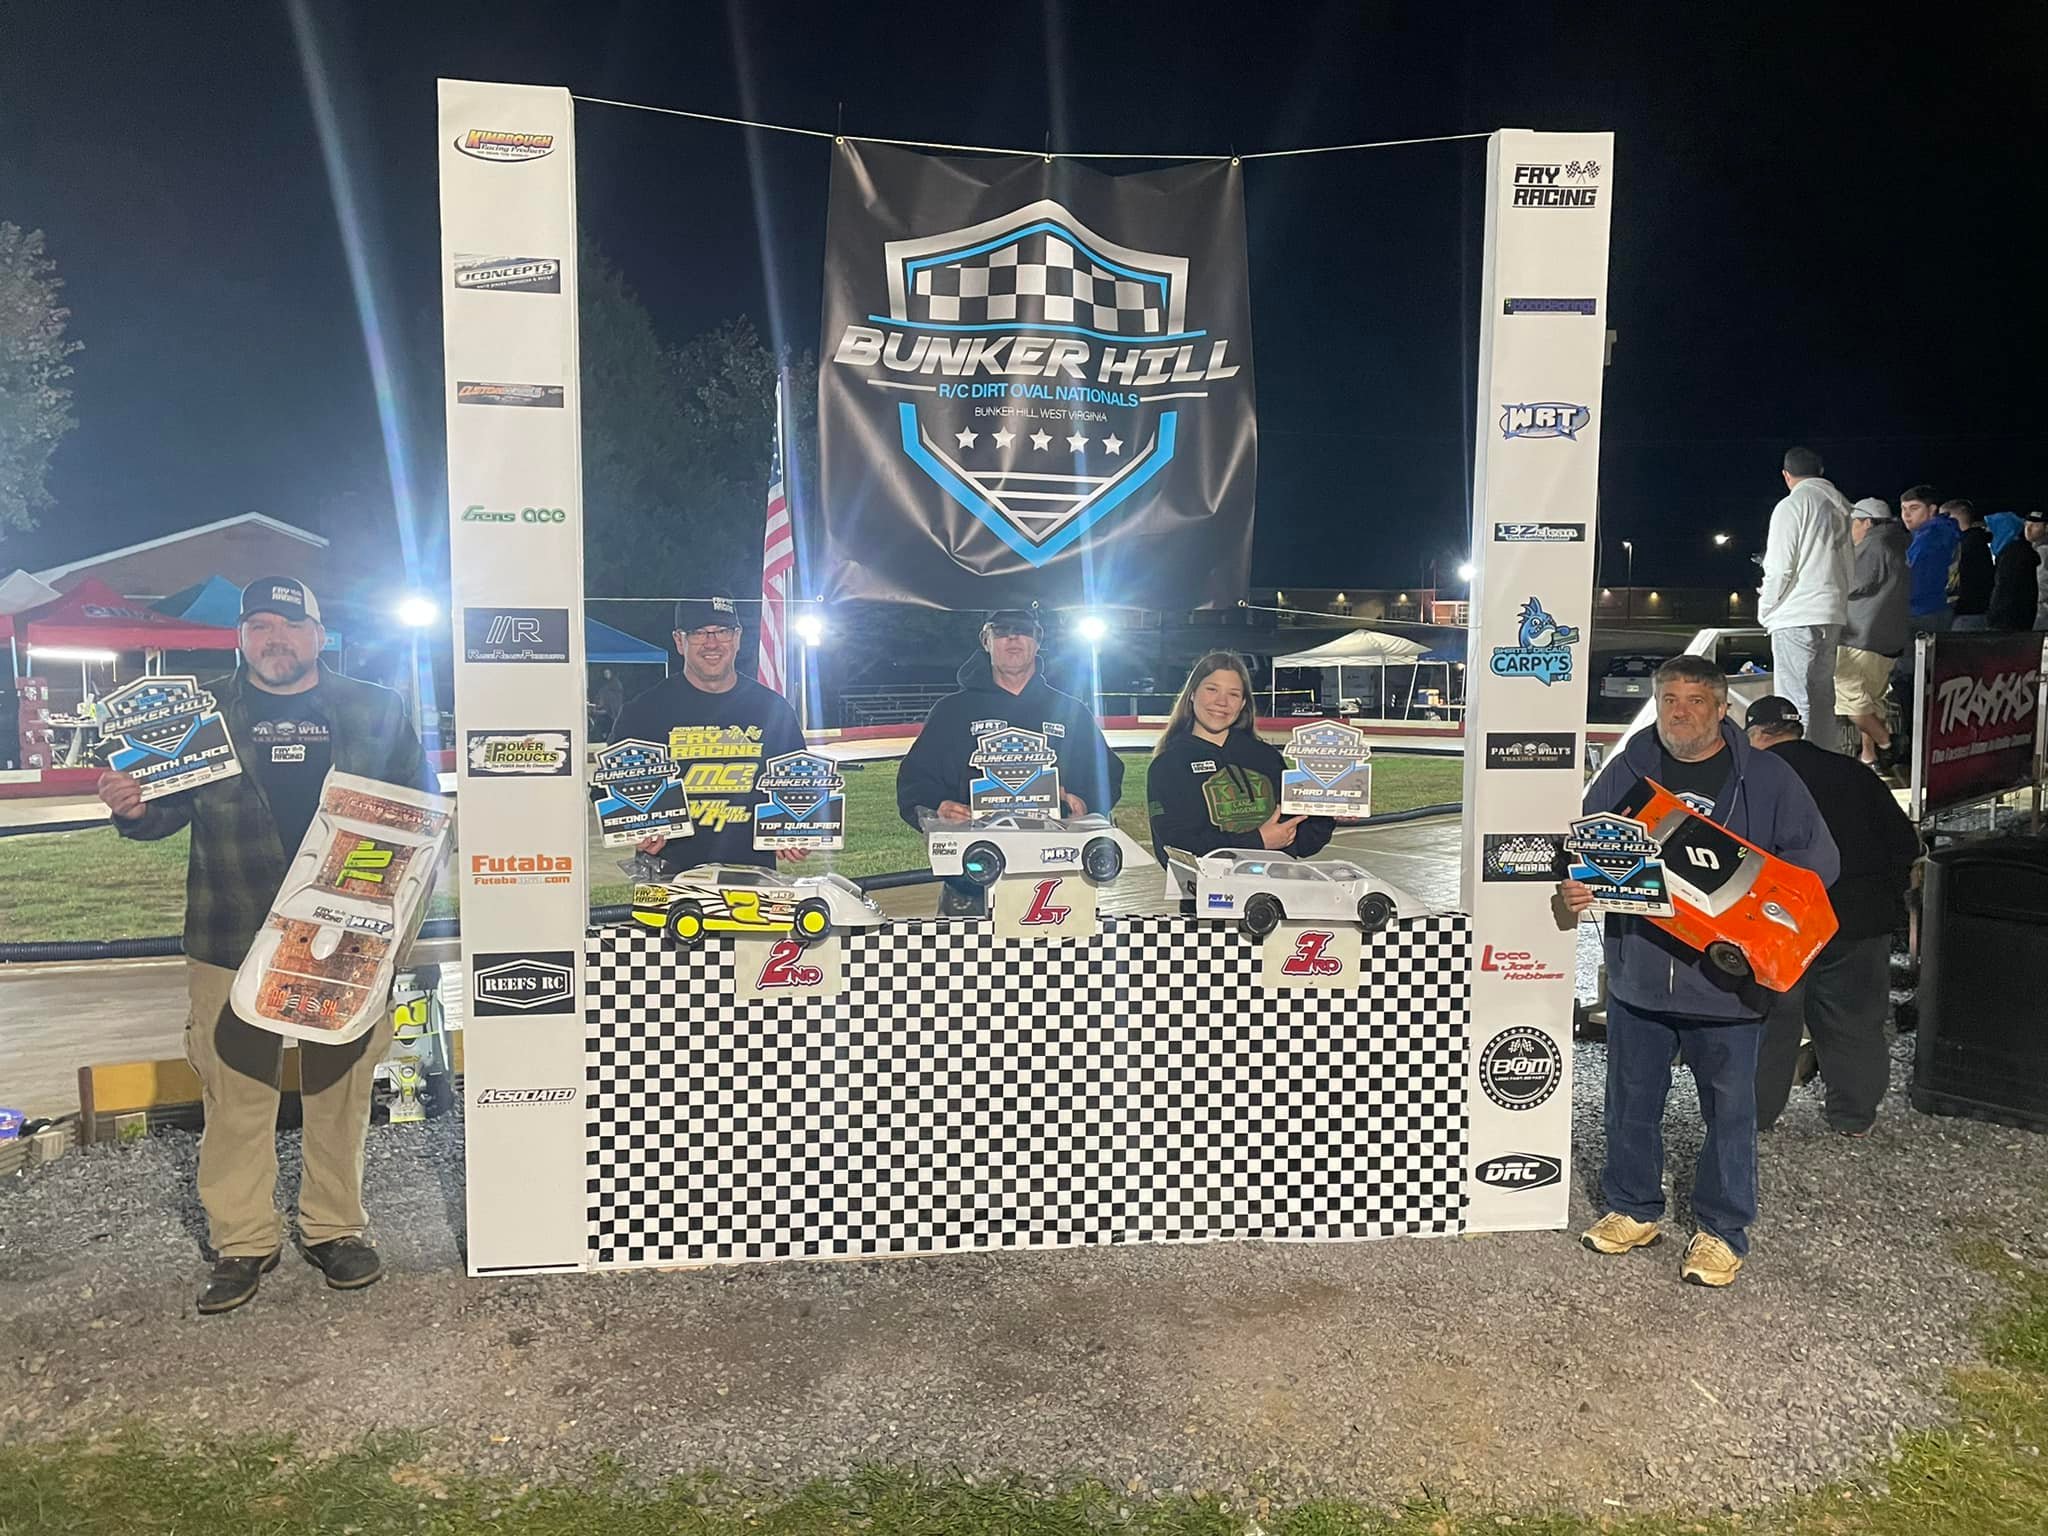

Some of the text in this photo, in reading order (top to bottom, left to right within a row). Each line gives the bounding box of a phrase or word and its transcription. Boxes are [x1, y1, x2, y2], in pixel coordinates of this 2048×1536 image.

[1514, 166, 1560, 184] FRY
[1513, 189, 1597, 205] RACING
[833, 325, 1240, 386] BUNKER HILL
[939, 383, 1139, 408] R/C DIRT OVAL NATIONALS
[974, 406, 1014, 418] BUNKER
[1040, 409, 1066, 419] WEST
[1068, 411, 1108, 422] VIRGINIA
[1508, 407, 1577, 435] WRT
[462, 505, 566, 523] Gens ace
[1493, 655, 1569, 672] CARPY'S
[1937, 670, 2037, 734] TRAXXAS
[104, 708, 170, 733] BUNKER
[173, 696, 211, 714] HILL
[670, 732, 721, 744] FRY
[183, 745, 230, 764] PLACE
[492, 742, 543, 757] POWER
[671, 744, 762, 757] RACING
[1288, 746, 1368, 757] BUNKER HILL
[1491, 747, 1521, 755] PAPA
[974, 753, 1054, 763] BUNKER HILL
[595, 763, 677, 781] BUNKER HILL
[760, 777, 843, 787] BUNKER HILL
[1292, 788, 1361, 797] THIRD PLACE
[604, 813, 648, 827] SECOND
[651, 808, 687, 820] PLACE
[760, 822, 840, 830] TOP QUALIFIER
[1568, 841, 1657, 853] BUNKER HILL
[472, 854, 571, 872] Futaba
[1042, 848, 1075, 863] WRT
[1685, 846, 1720, 870] 5
[635, 889, 651, 897] FRY
[1620, 886, 1659, 896] PLACE
[634, 896, 668, 904] RACING
[719, 888, 771, 925] 2
[756, 938, 823, 989] 2ND
[485, 976, 564, 991] REEFS RC
[478, 1088, 576, 1104] ASSOCIATED
